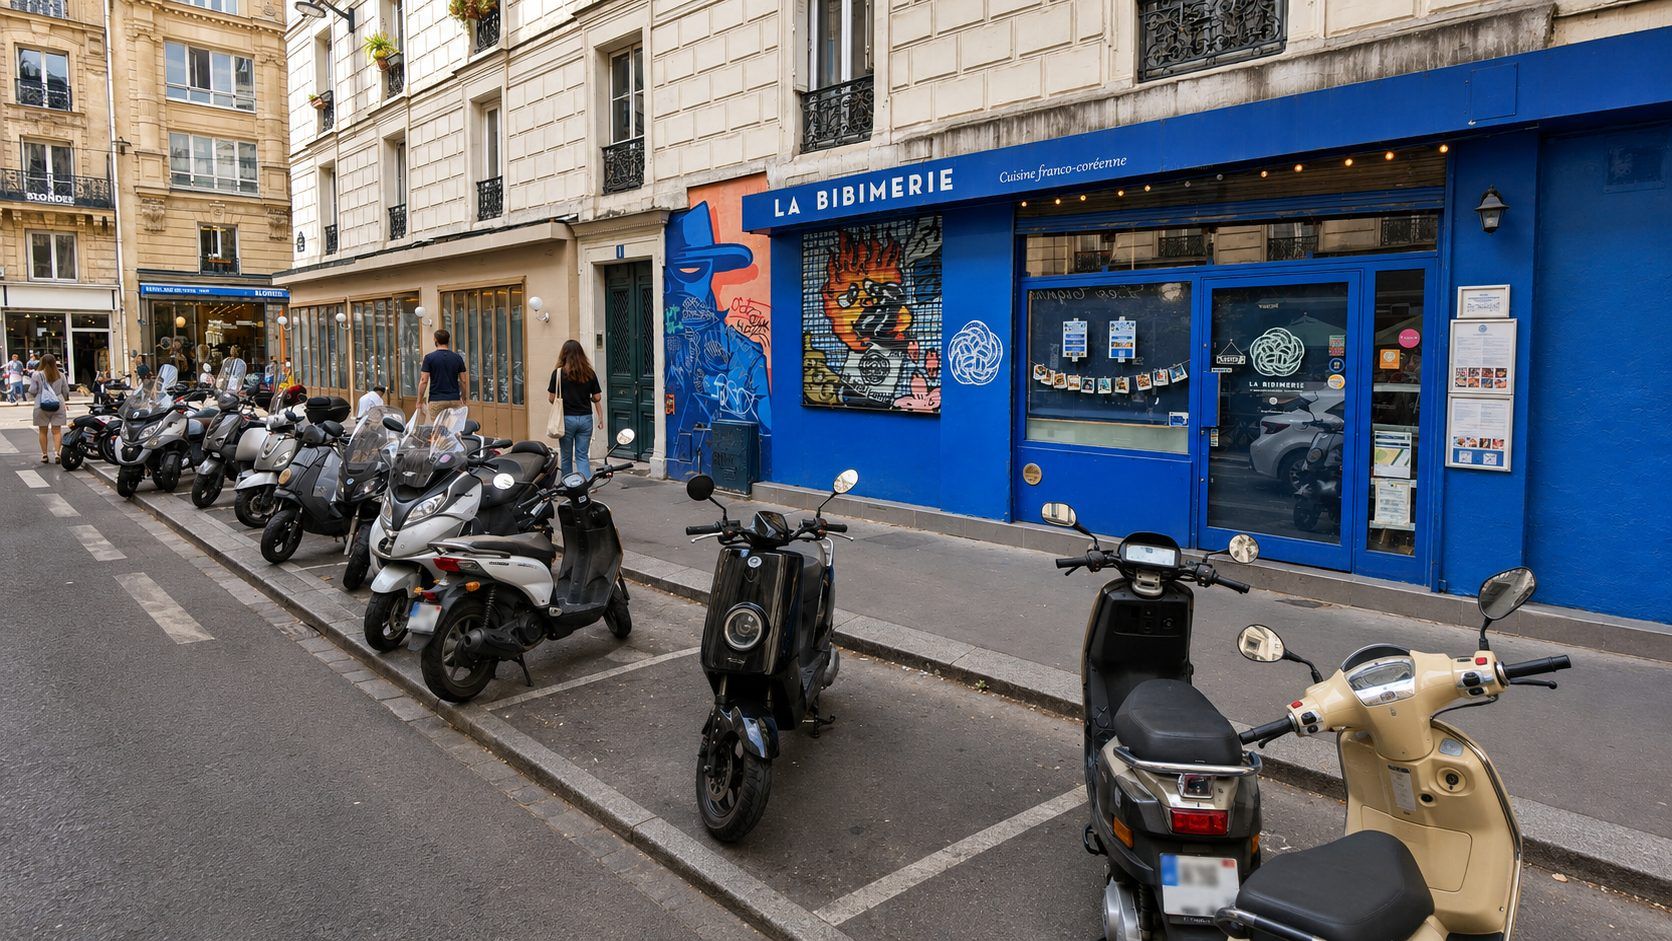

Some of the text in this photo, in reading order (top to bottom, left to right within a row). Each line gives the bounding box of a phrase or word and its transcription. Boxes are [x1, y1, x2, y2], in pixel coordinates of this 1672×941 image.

[999, 157, 1127, 183] Cuisine franco-coréenne
[774, 168, 953, 217] LA BIBIMERIE
